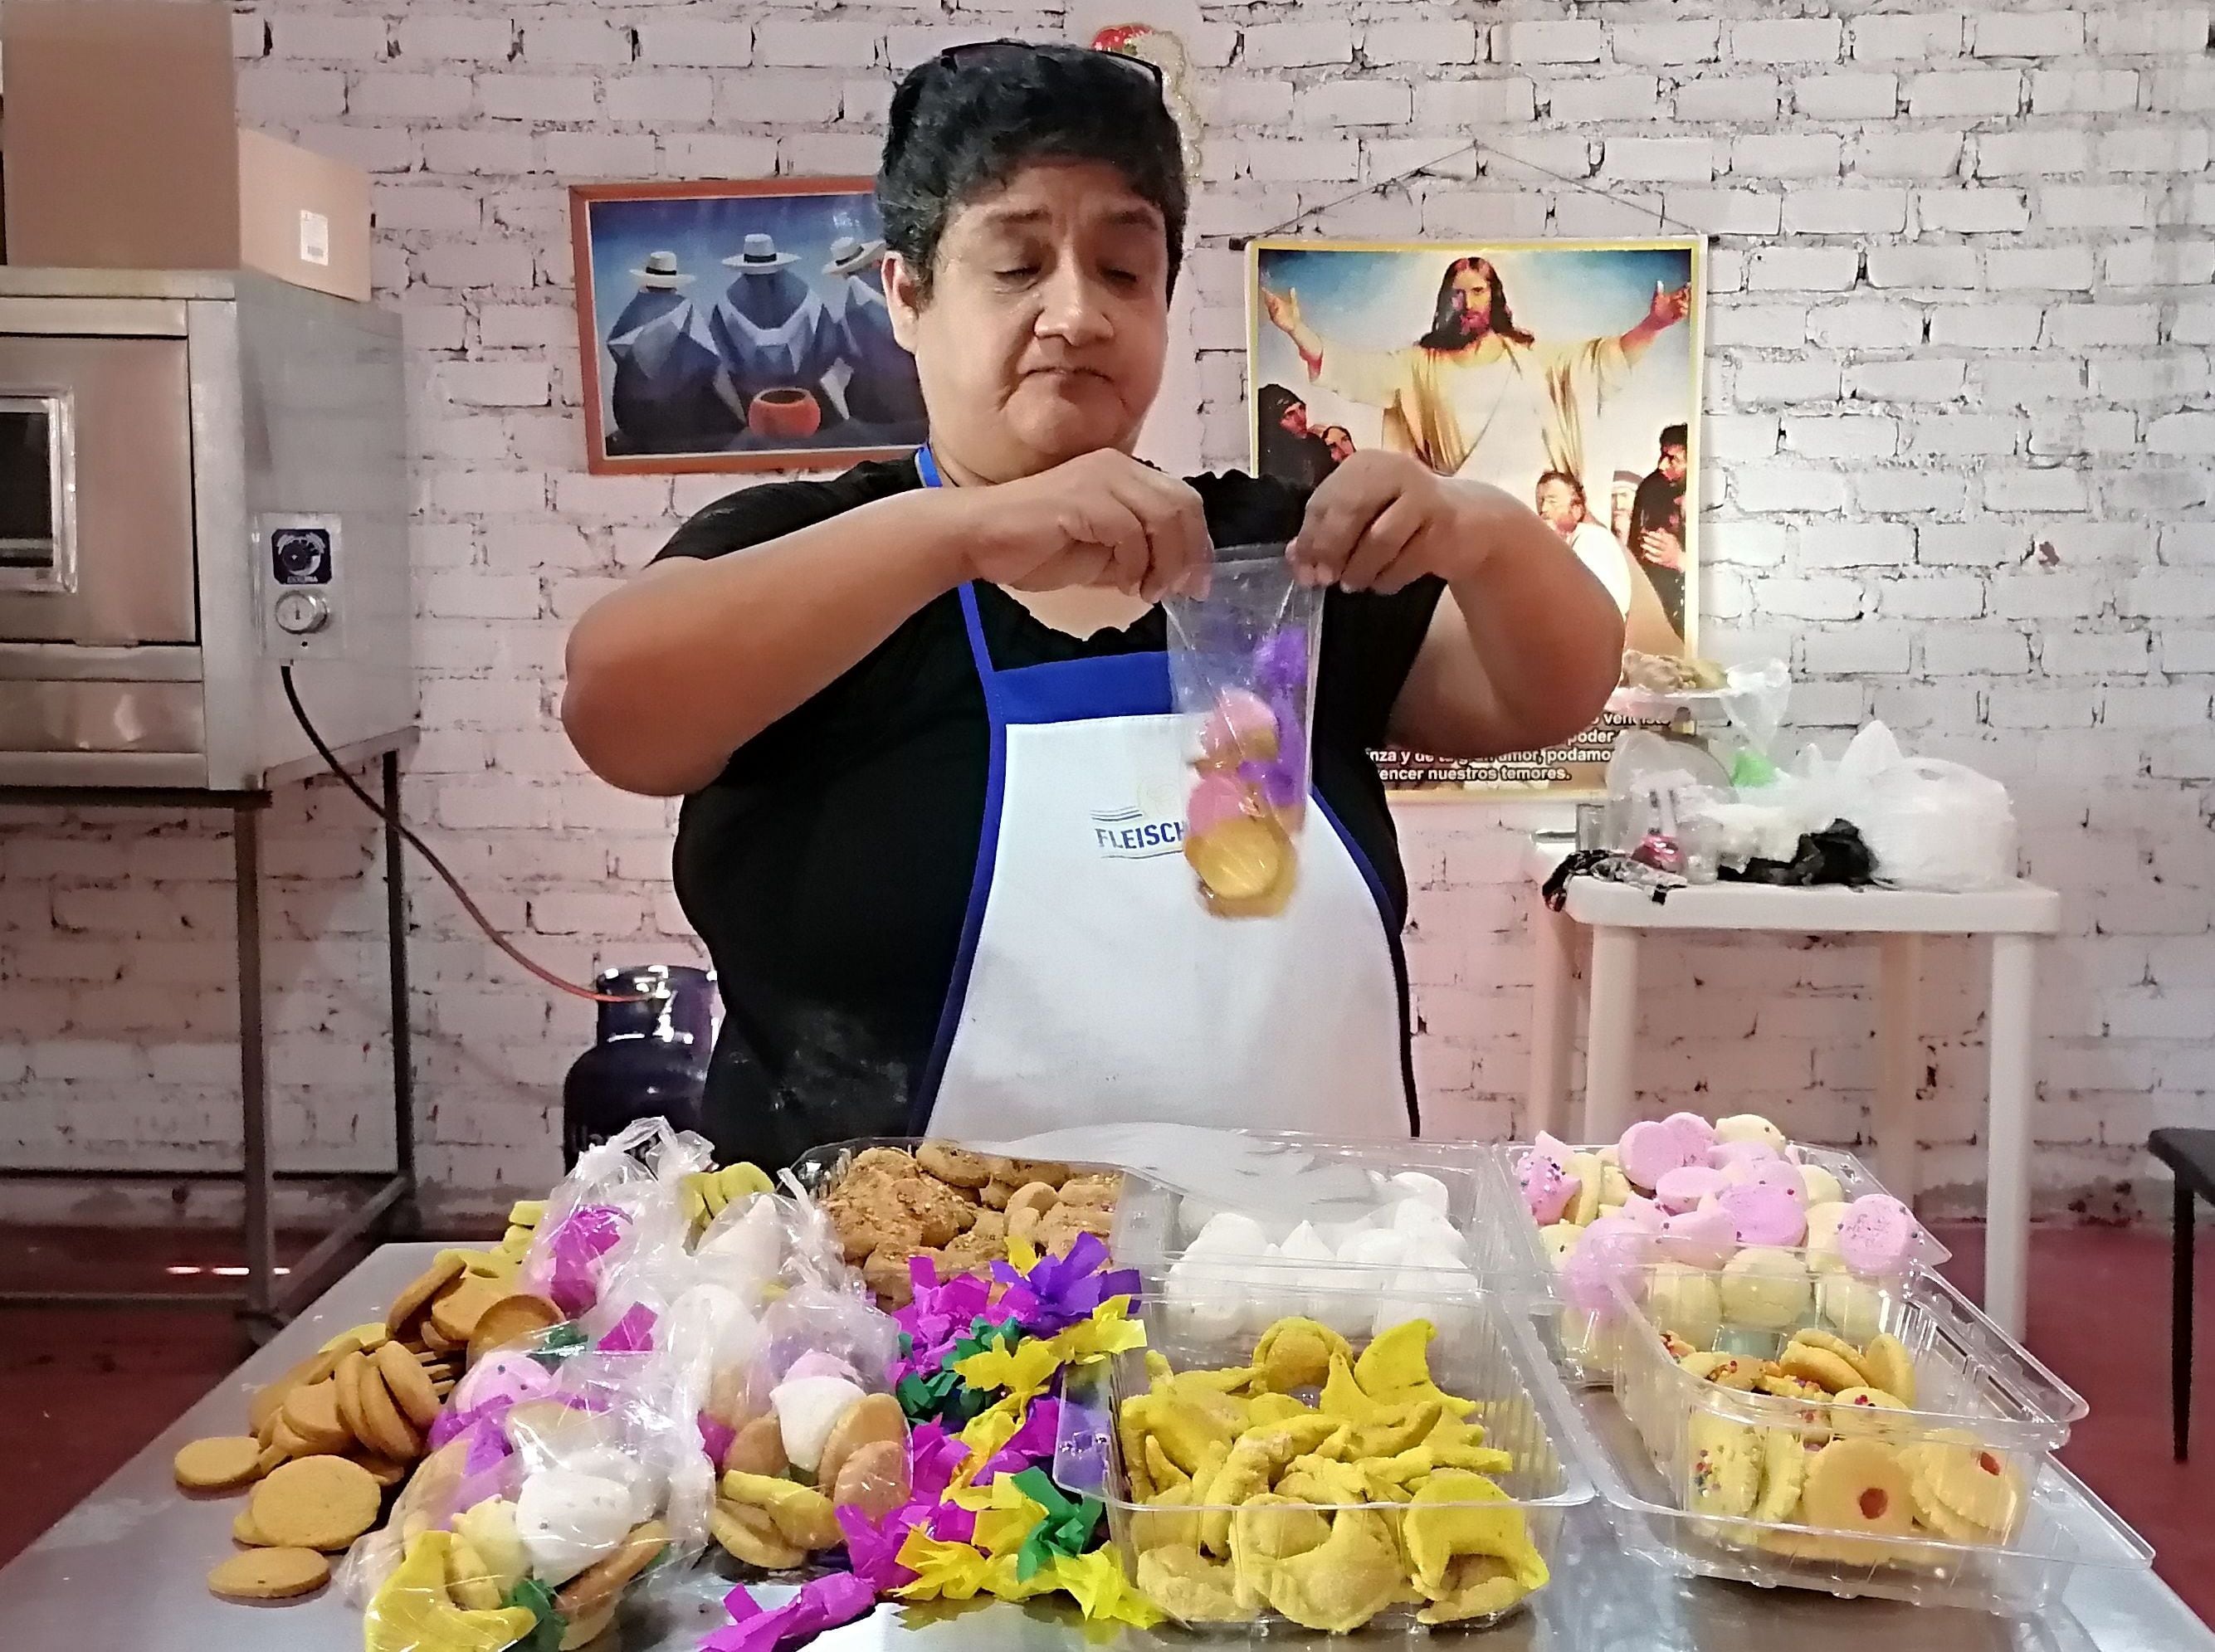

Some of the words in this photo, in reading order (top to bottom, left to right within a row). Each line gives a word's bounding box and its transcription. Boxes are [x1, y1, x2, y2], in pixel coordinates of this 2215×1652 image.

[1365, 748, 1397, 763] nza
[1400, 751, 1411, 765] y
[1546, 747, 1612, 764] podamo
[1378, 768, 1424, 781] encer
[1427, 765, 1497, 781] nuestros
[1500, 766, 1571, 781] temores.
